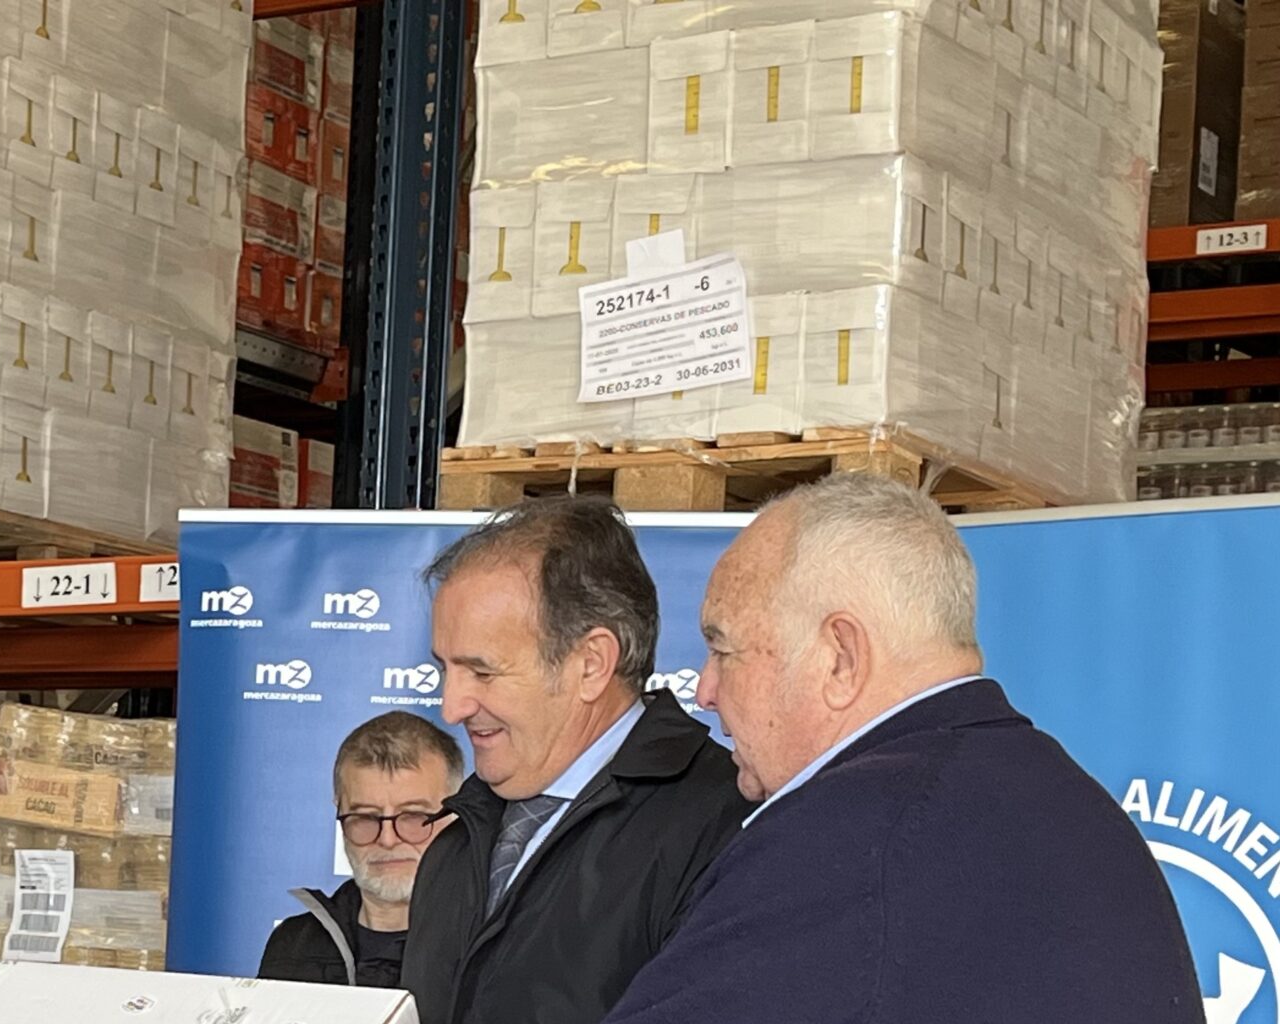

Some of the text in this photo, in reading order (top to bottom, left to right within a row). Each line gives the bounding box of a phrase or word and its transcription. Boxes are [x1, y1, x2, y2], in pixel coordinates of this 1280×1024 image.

[1218, 231, 1249, 247] 12-3
[596, 275, 710, 316] 252174-1 -6
[674, 311, 686, 320] DE
[688, 300, 731, 317] PESCADO
[596, 374, 663, 395] BE03-23-2
[676, 358, 741, 381] 30-06-2031
[50, 574, 90, 596] 22-1
[190, 618, 263, 629] mercazaragoza
[311, 620, 391, 632] mercazaragoza
[243, 691, 322, 703] mercazaragoza
[370, 695, 443, 708] mercazarago
